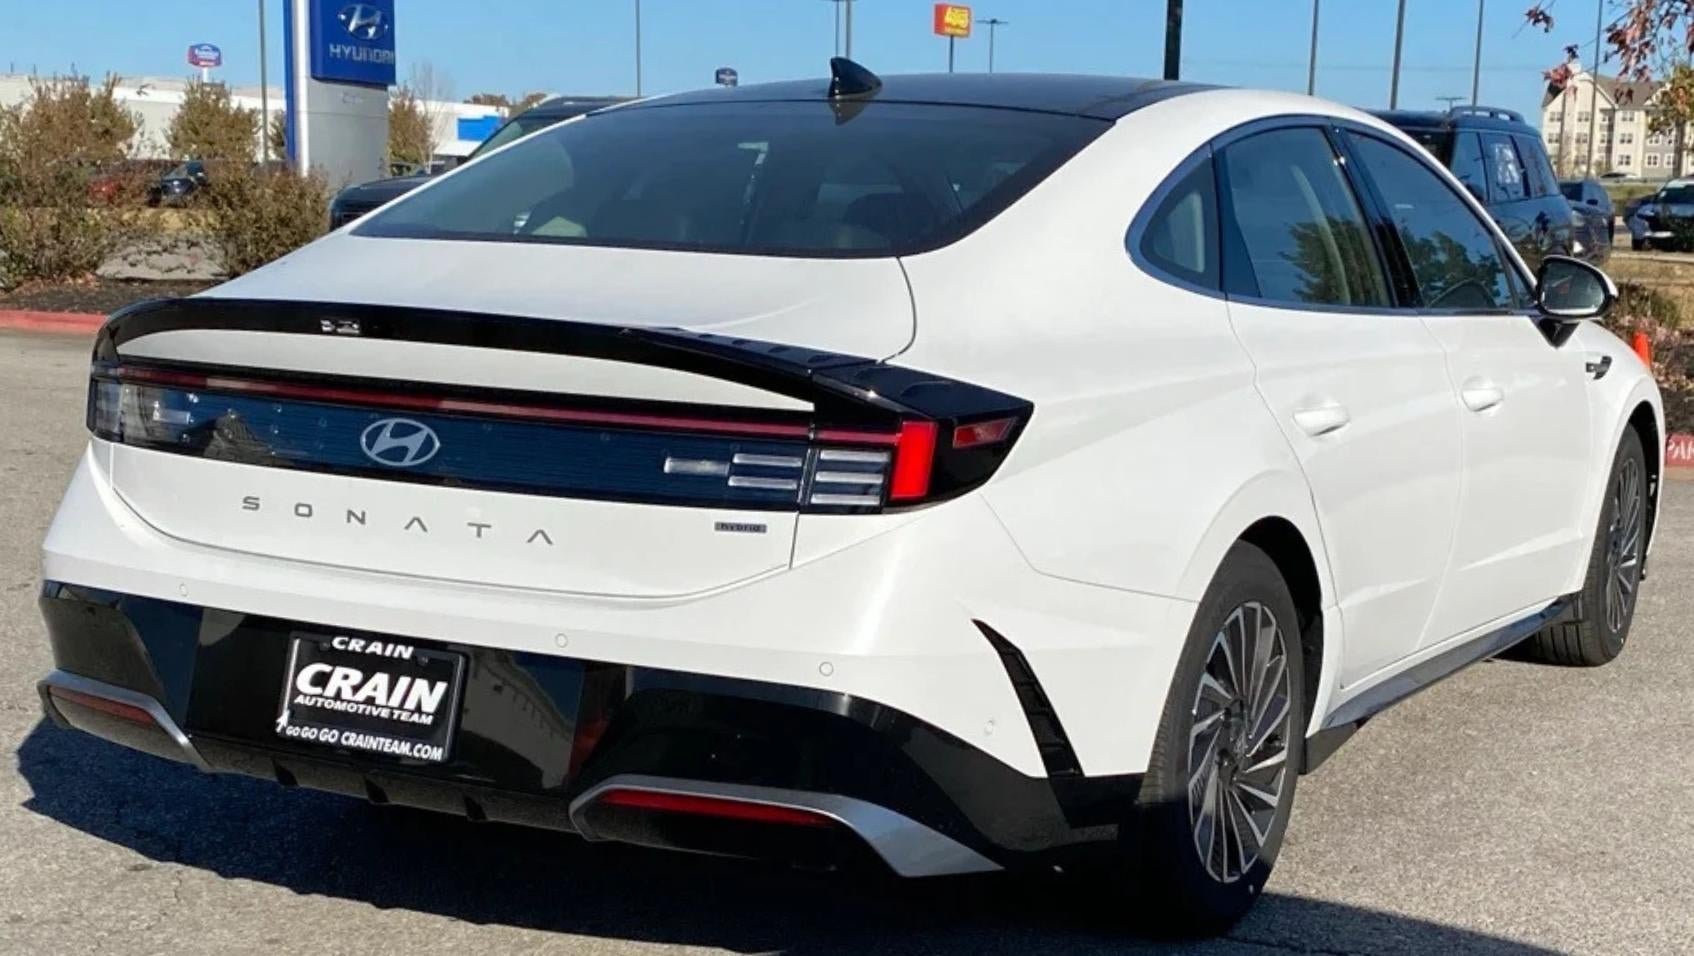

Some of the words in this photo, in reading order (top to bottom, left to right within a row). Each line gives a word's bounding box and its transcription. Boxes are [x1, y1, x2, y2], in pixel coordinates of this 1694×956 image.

[242, 496, 553, 545] SONATA
[332, 636, 414, 660] CRAIN
[296, 662, 448, 713] CRAIN
[294, 695, 391, 717] AUTOMOTIVE
[393, 710, 434, 725] TEAM
[286, 725, 300, 736] GO
[301, 726, 318, 739] GO
[319, 727, 339, 743] GO
[340, 732, 443, 761] CRAINTEAM.COM
